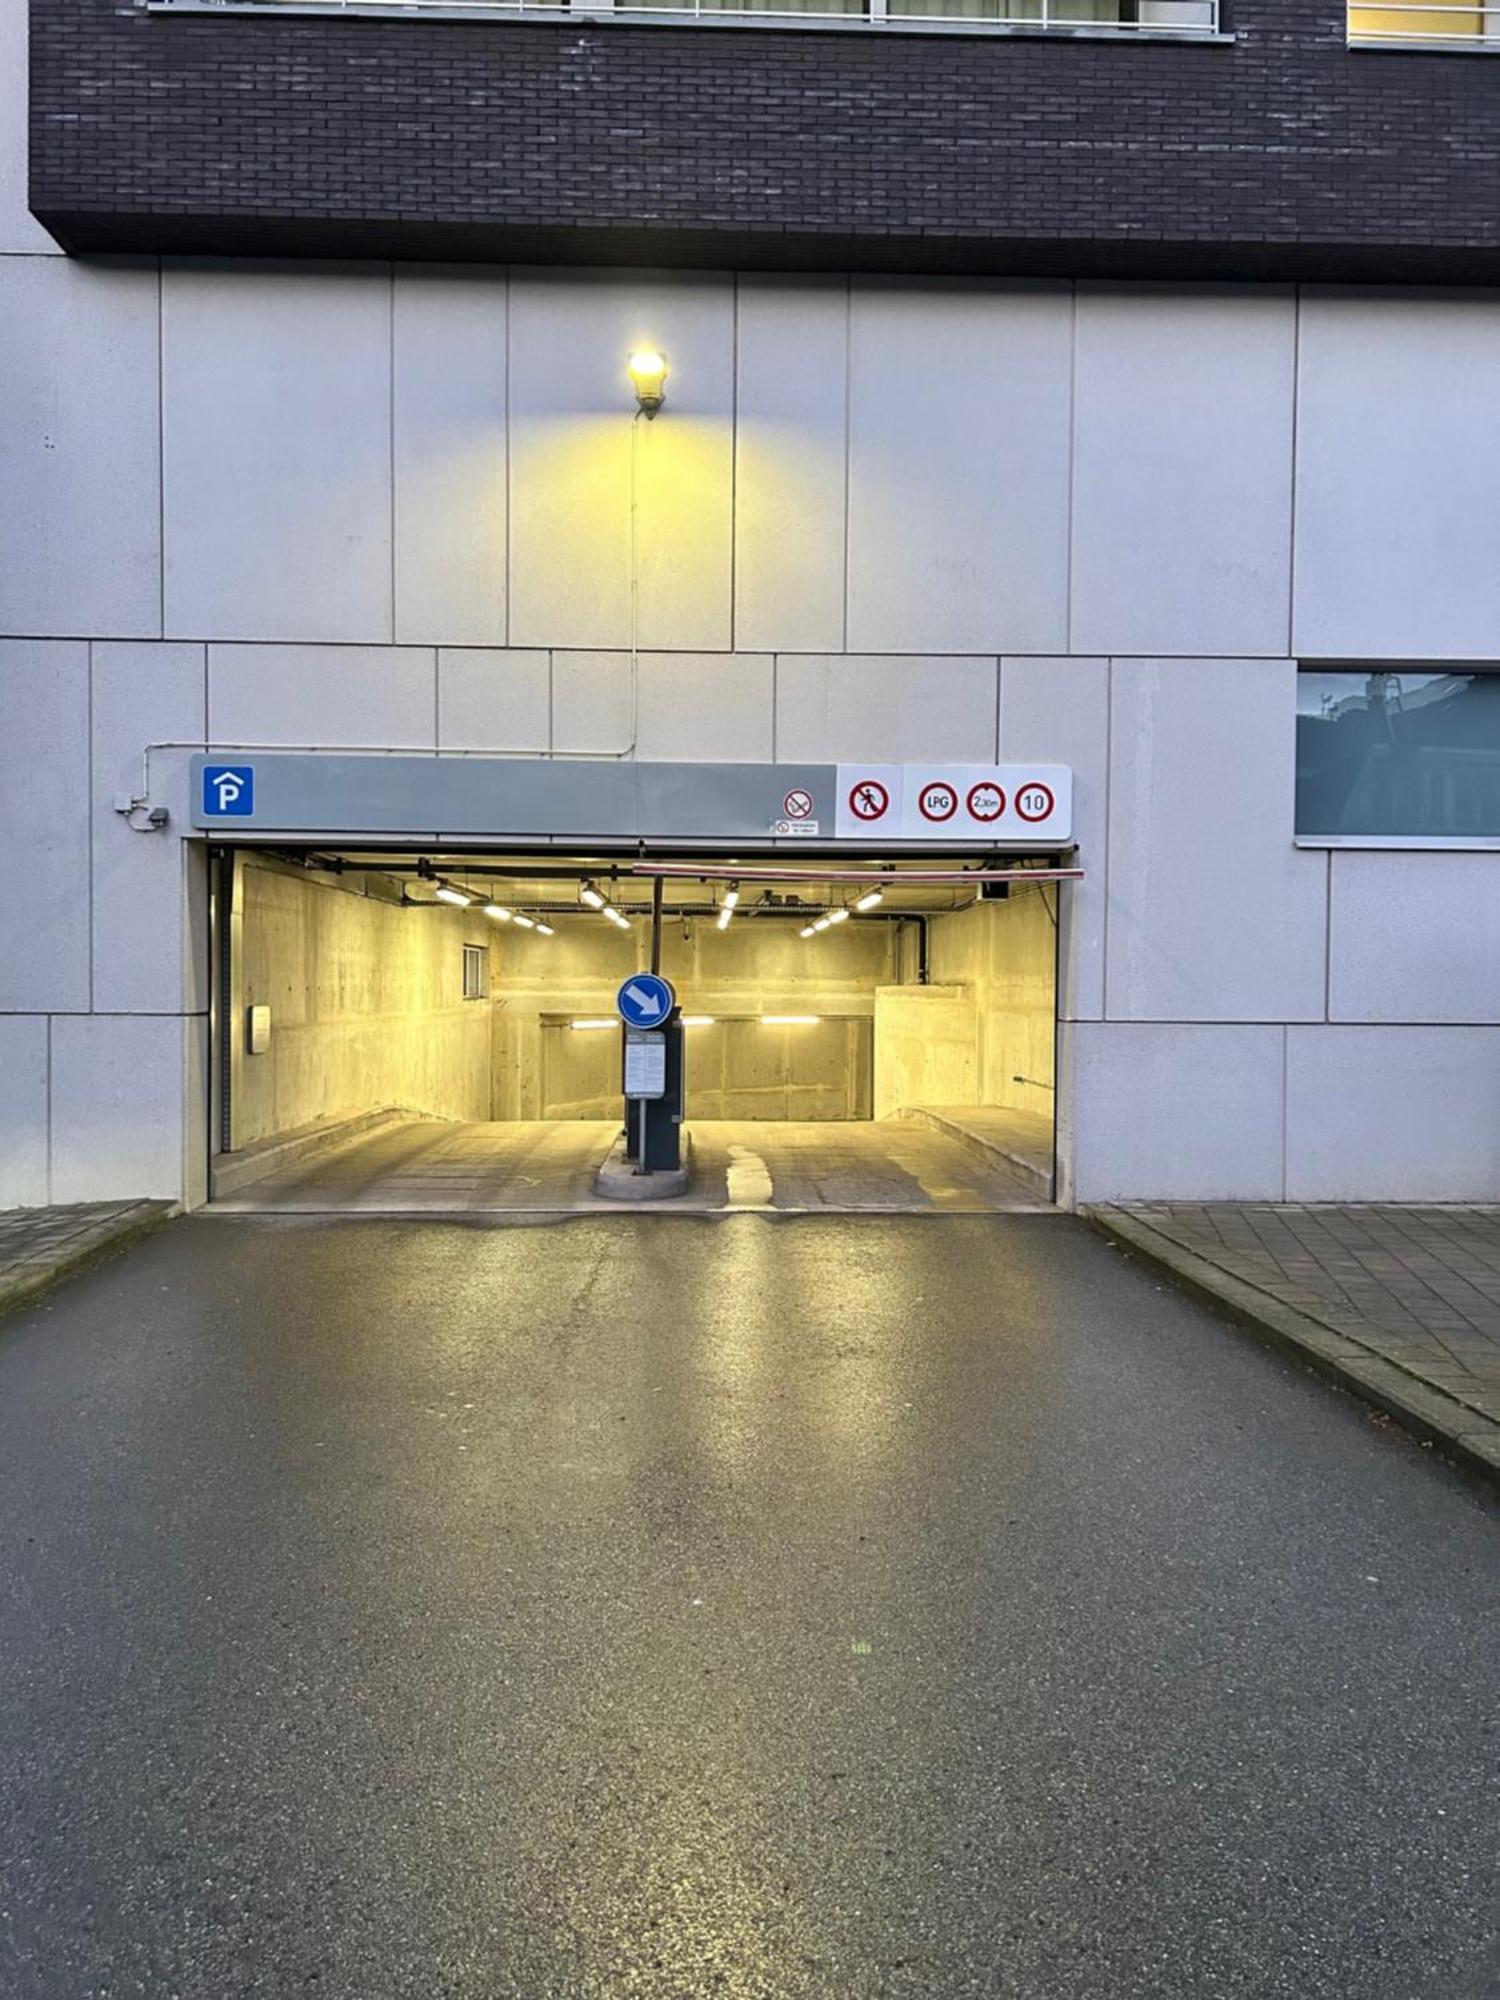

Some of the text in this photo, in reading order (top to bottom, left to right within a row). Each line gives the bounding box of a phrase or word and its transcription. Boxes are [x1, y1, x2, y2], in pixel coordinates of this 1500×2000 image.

[220, 784, 239, 810] P
[927, 796, 949, 808] LPG
[1025, 795, 1044, 810] 10
